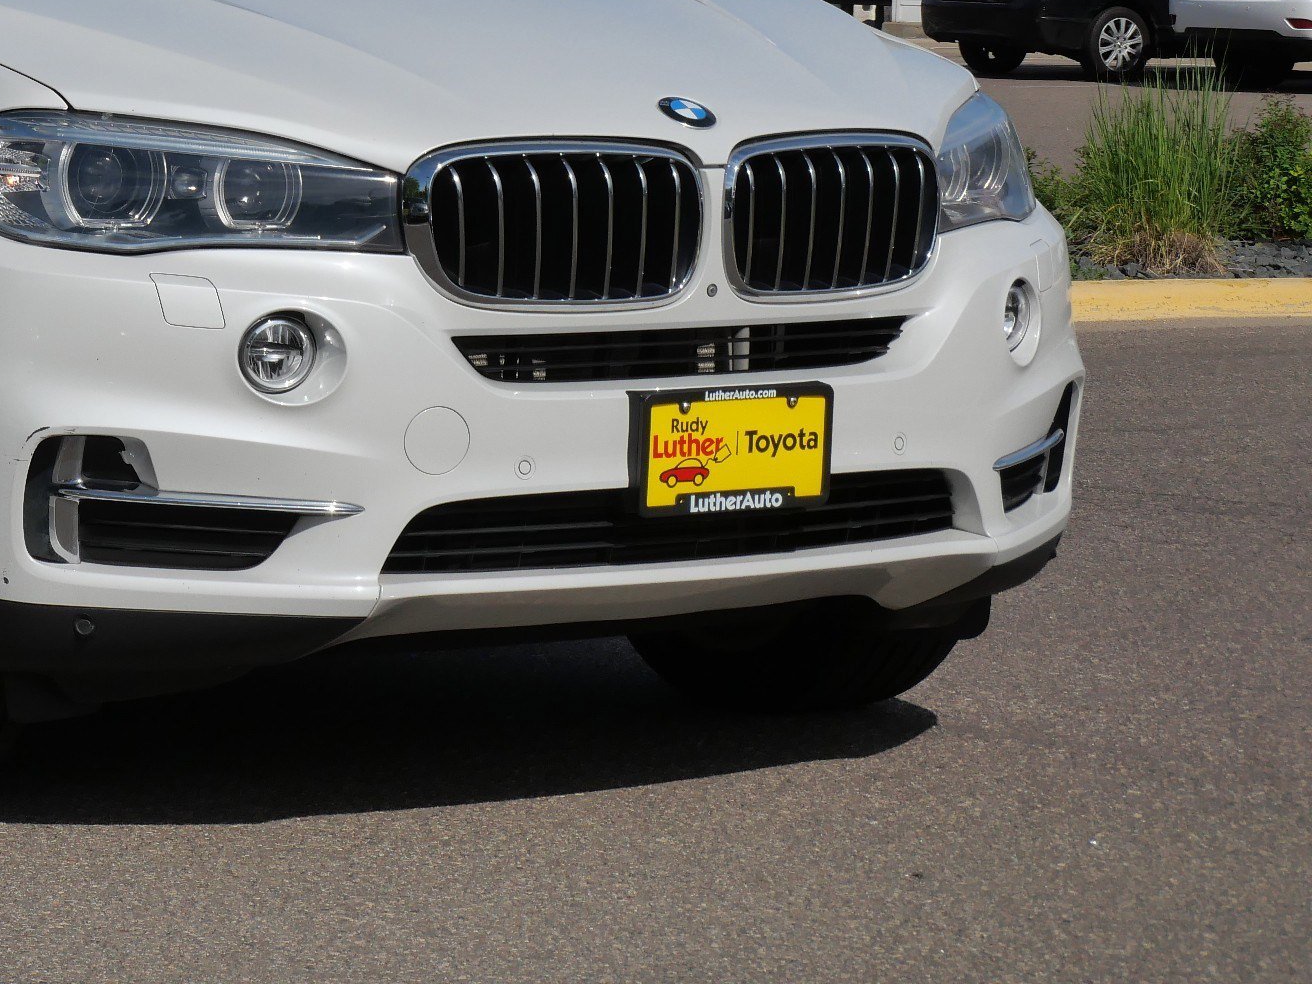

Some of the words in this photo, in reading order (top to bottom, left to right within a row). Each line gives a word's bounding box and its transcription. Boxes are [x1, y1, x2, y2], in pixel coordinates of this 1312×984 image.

[704, 389, 777, 402] LutherAuto.com
[671, 416, 708, 437] Rudy
[652, 433, 724, 459] Luther
[744, 427, 819, 458] Toyota
[689, 491, 783, 513] LutherAuto
